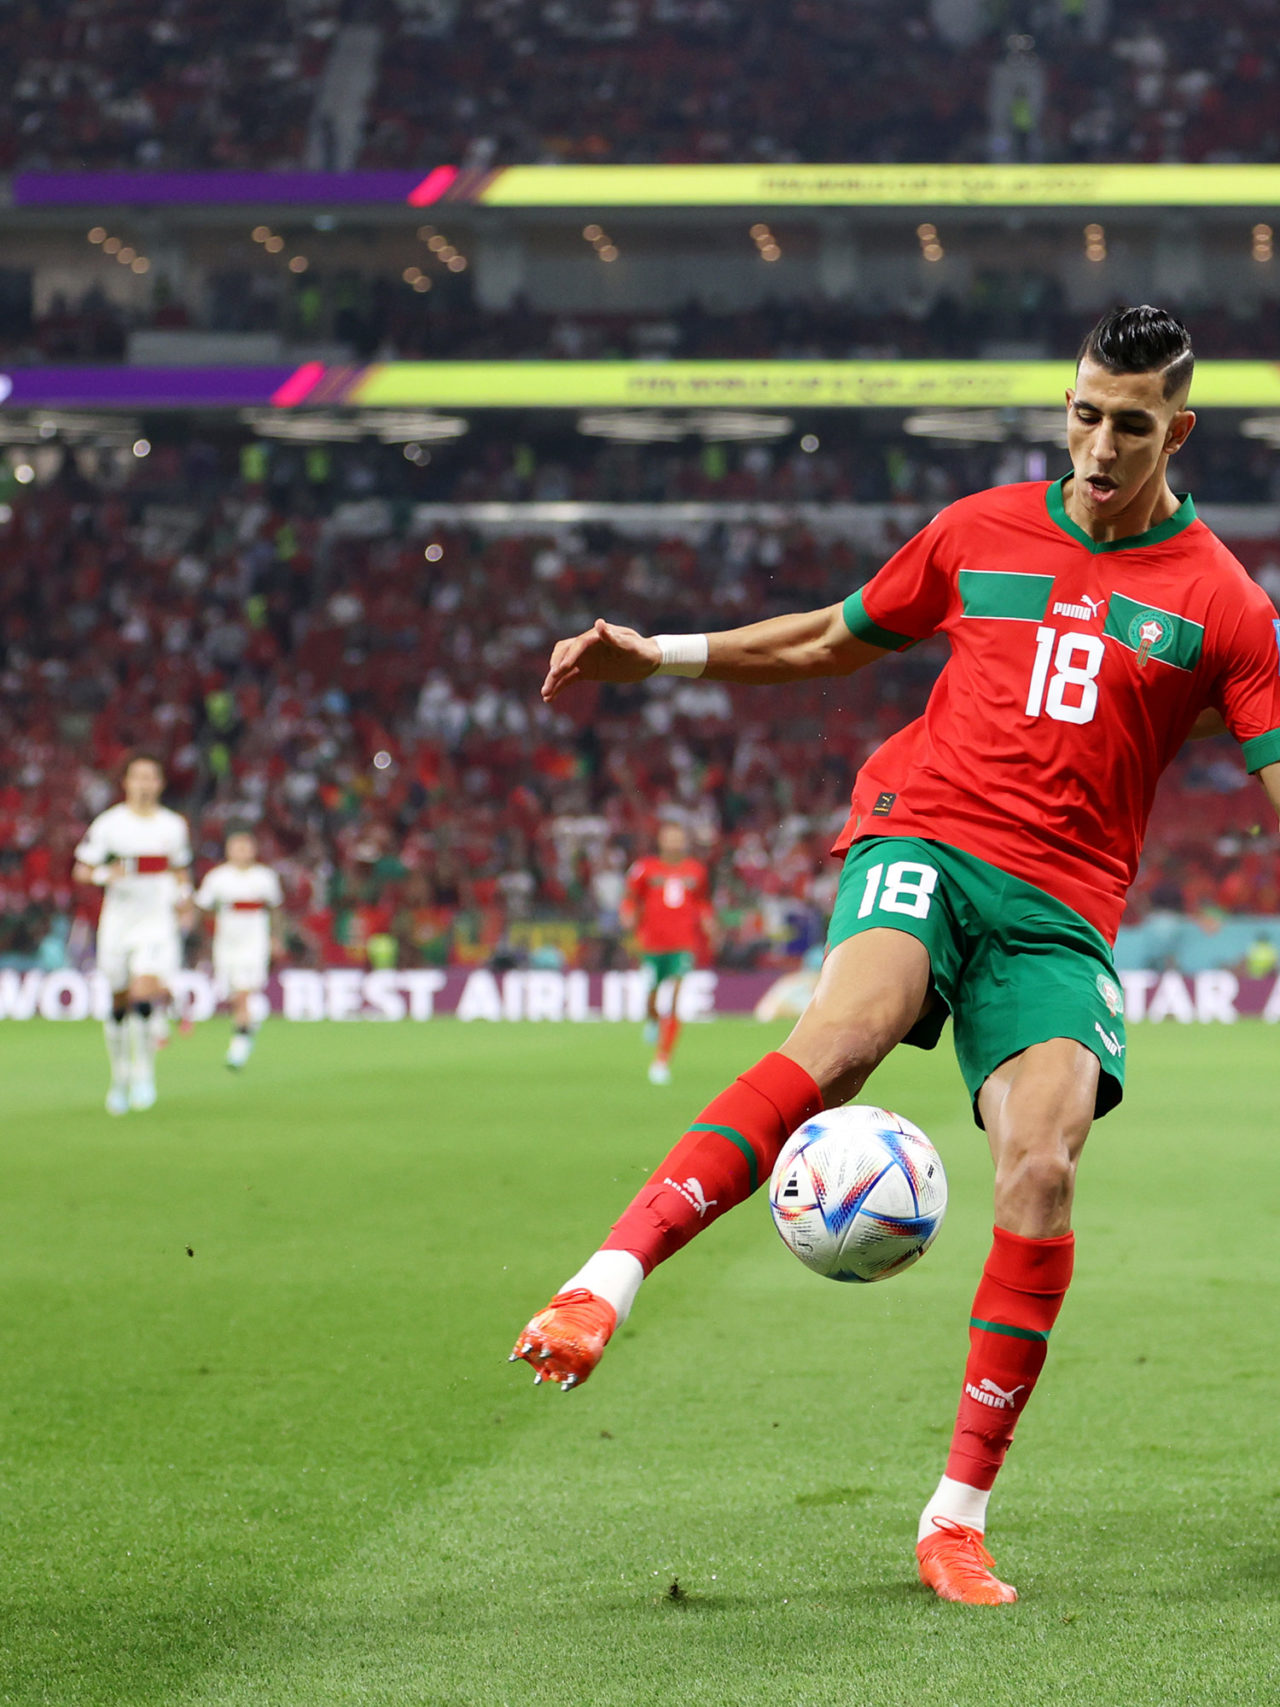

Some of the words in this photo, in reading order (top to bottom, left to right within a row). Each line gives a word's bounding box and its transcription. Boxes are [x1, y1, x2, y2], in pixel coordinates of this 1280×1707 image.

[1052, 601, 1092, 622] PUMA
[1025, 626, 1105, 725] 18
[857, 861, 939, 920] 18
[279, 968, 447, 1022] BEST
[965, 1381, 1007, 1409] PUMA
